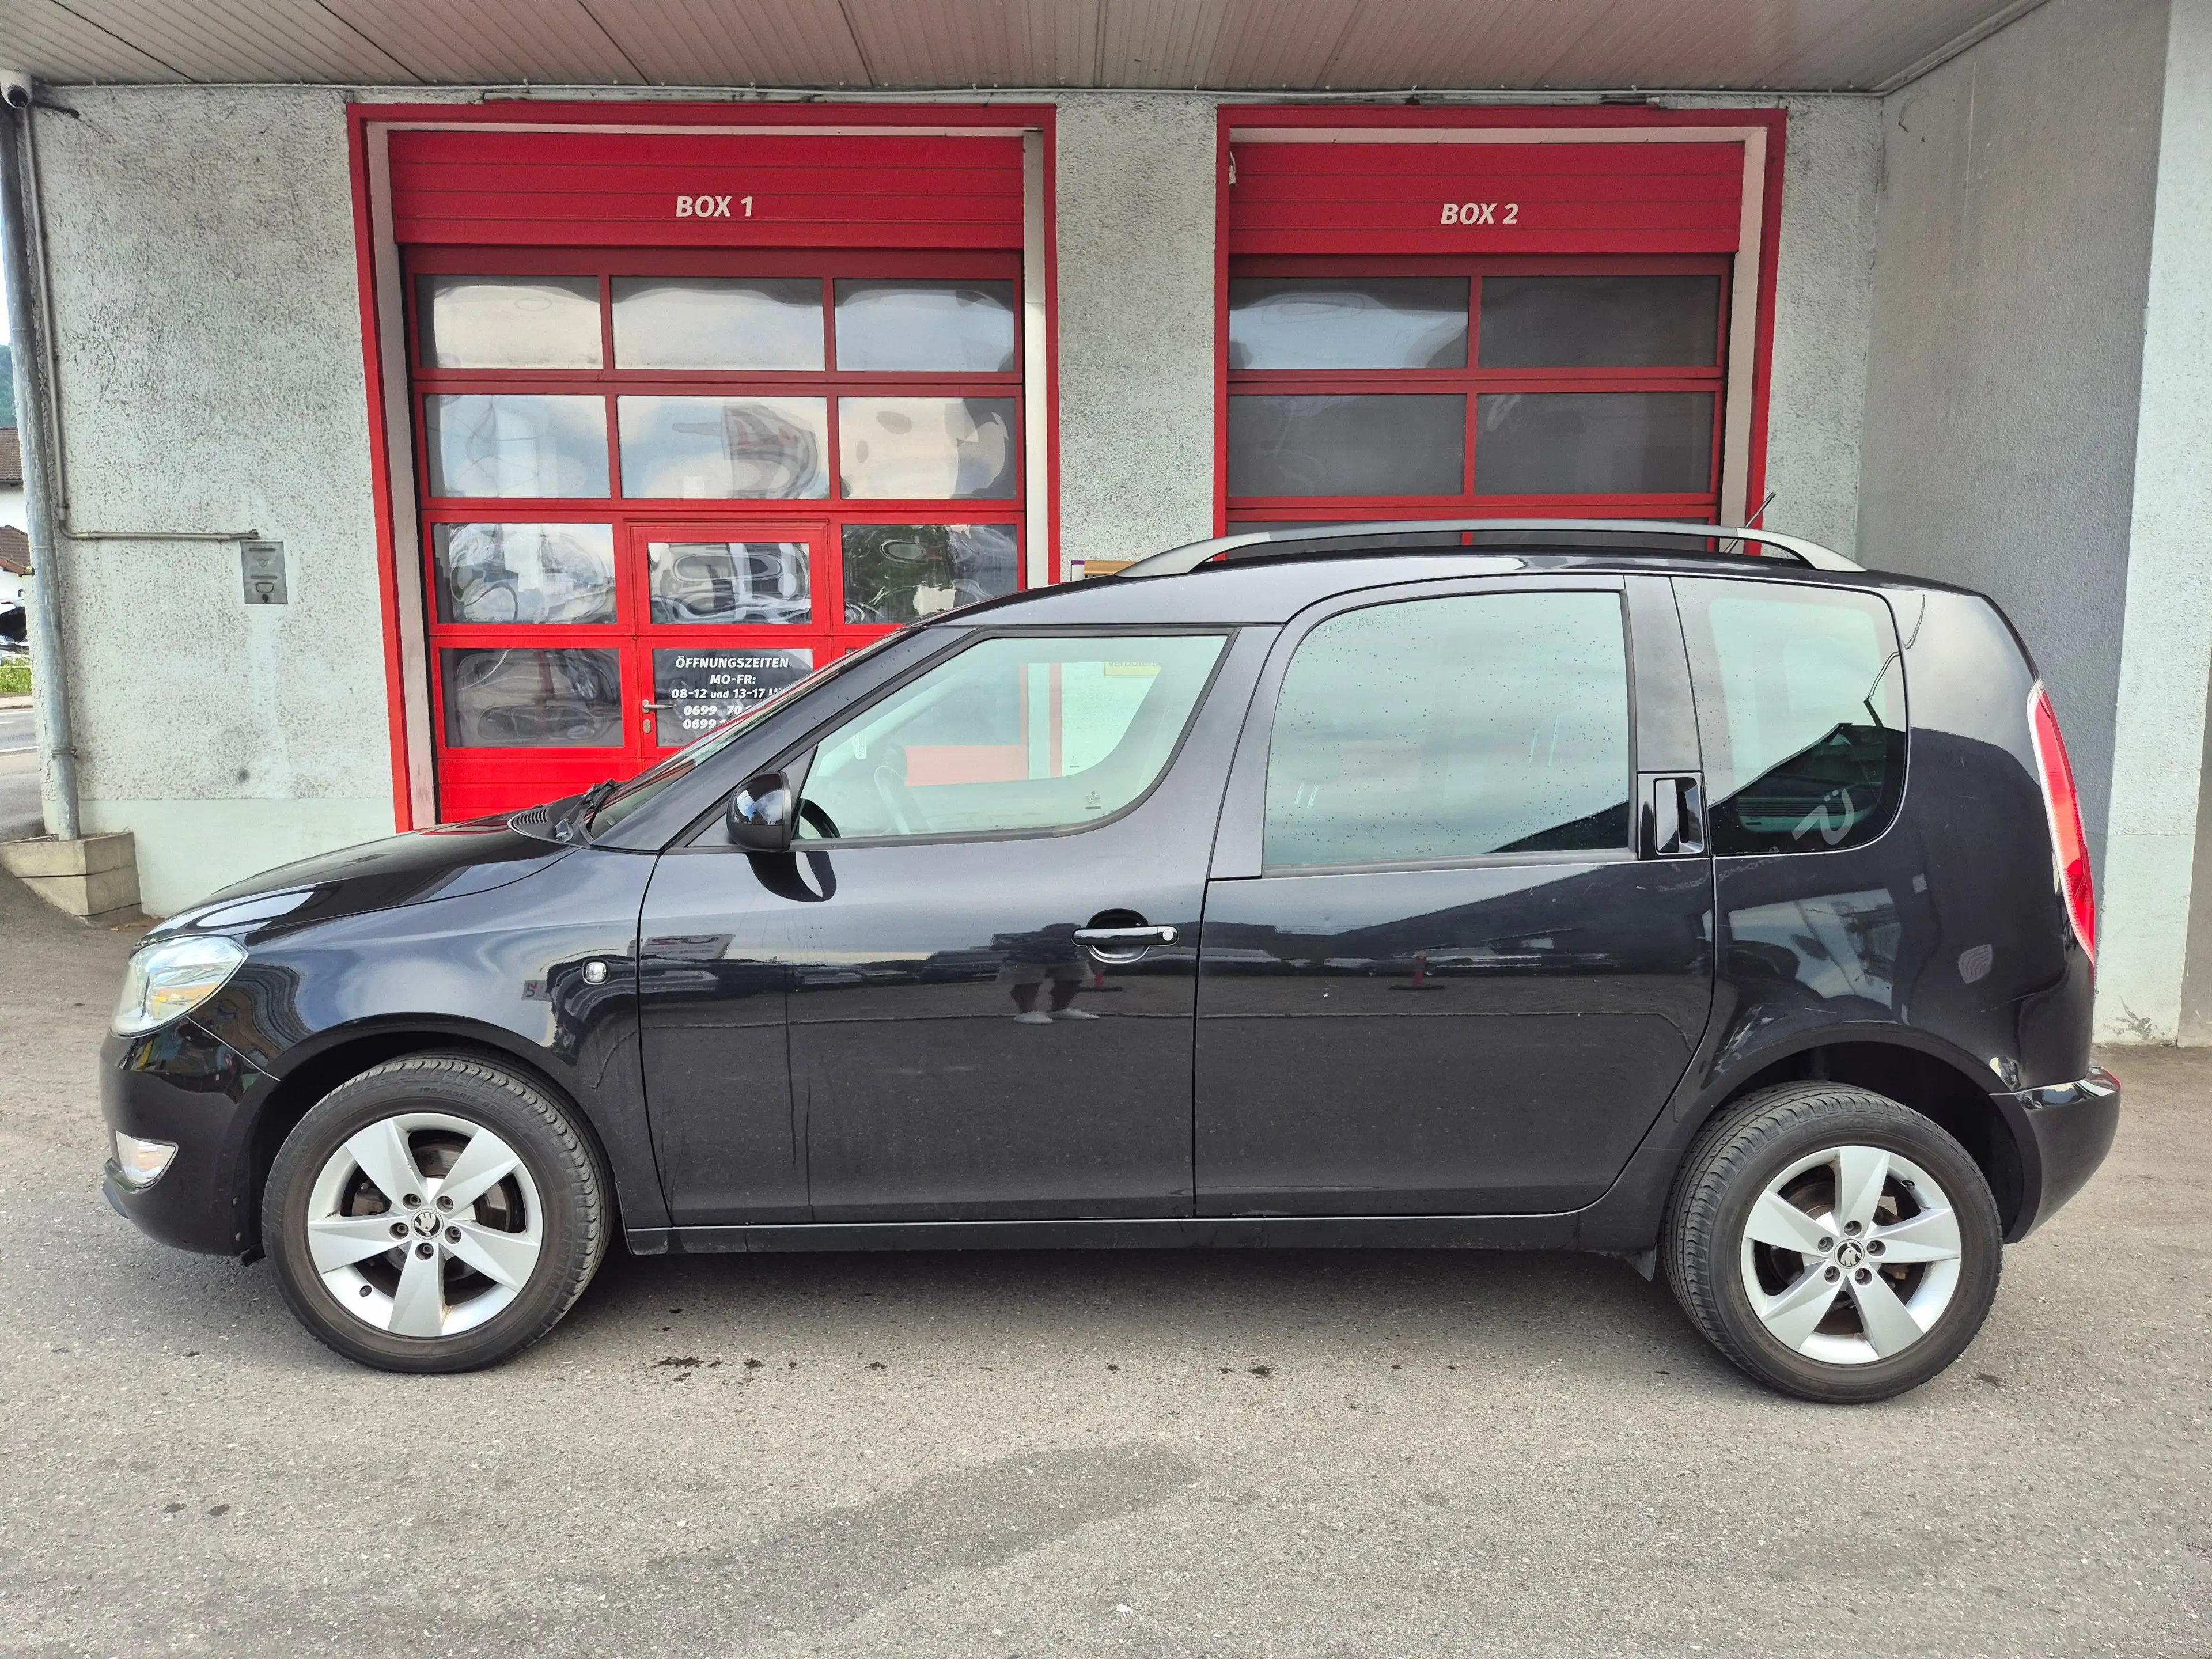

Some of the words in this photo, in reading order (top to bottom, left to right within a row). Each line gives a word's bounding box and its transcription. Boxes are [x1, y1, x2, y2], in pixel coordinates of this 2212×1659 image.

[676, 195, 732, 217] BOX
[740, 196, 753, 217] 1
[1440, 203, 1498, 225] BOX
[1502, 203, 1519, 225] 2
[675, 655, 790, 668] ÖFFNUNGSZEITEN
[709, 674, 756, 685] MO-FR:
[671, 688, 707, 699] 08-12
[710, 690, 729, 699] und
[732, 688, 766, 699] 13-17
[683, 705, 717, 715] 0699
[683, 718, 717, 729] 0699
